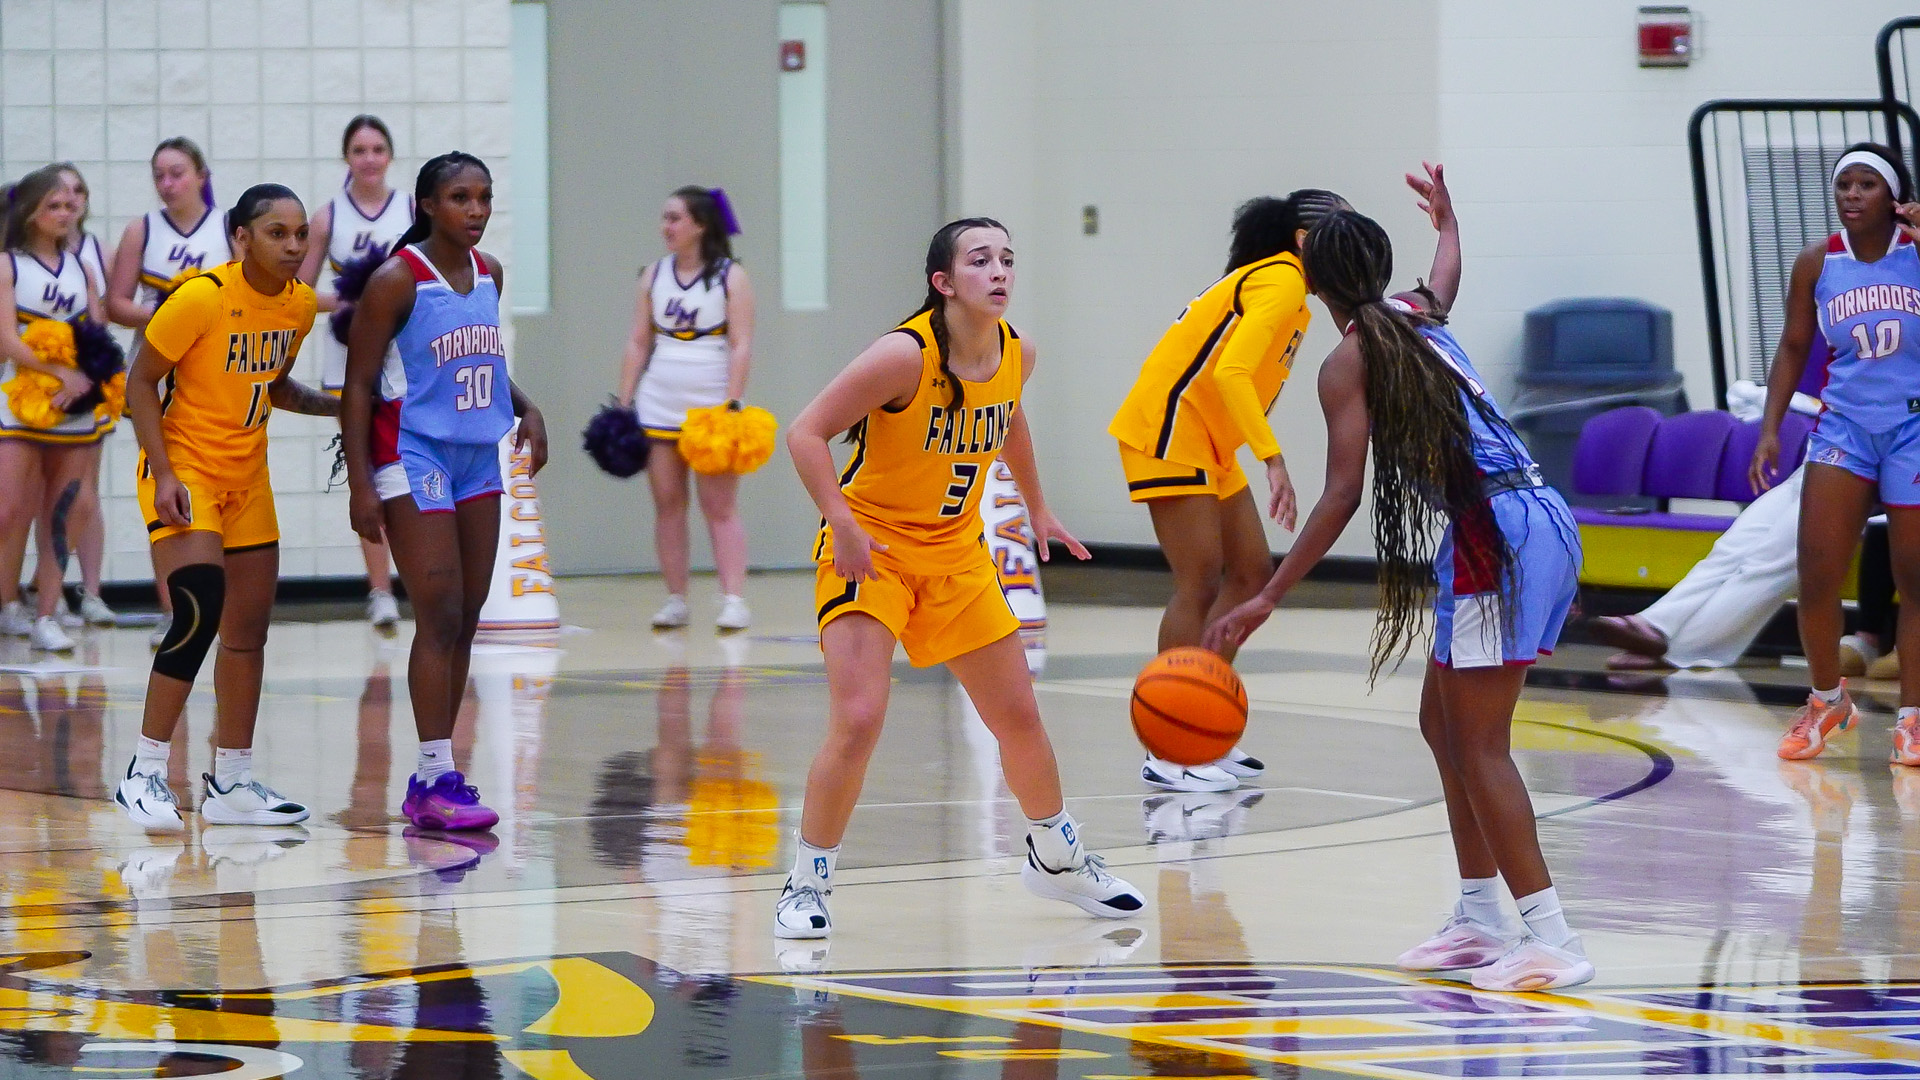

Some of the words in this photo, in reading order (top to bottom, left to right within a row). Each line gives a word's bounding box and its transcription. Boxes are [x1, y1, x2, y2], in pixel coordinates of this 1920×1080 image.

[168, 243, 207, 270] UM
[43, 283, 78, 313] UM
[664, 297, 699, 327] UM
[430, 323, 505, 368] TORNADOE
[1851, 318, 1901, 360] 10
[455, 364, 494, 412] 30
[939, 461, 979, 518] 3
